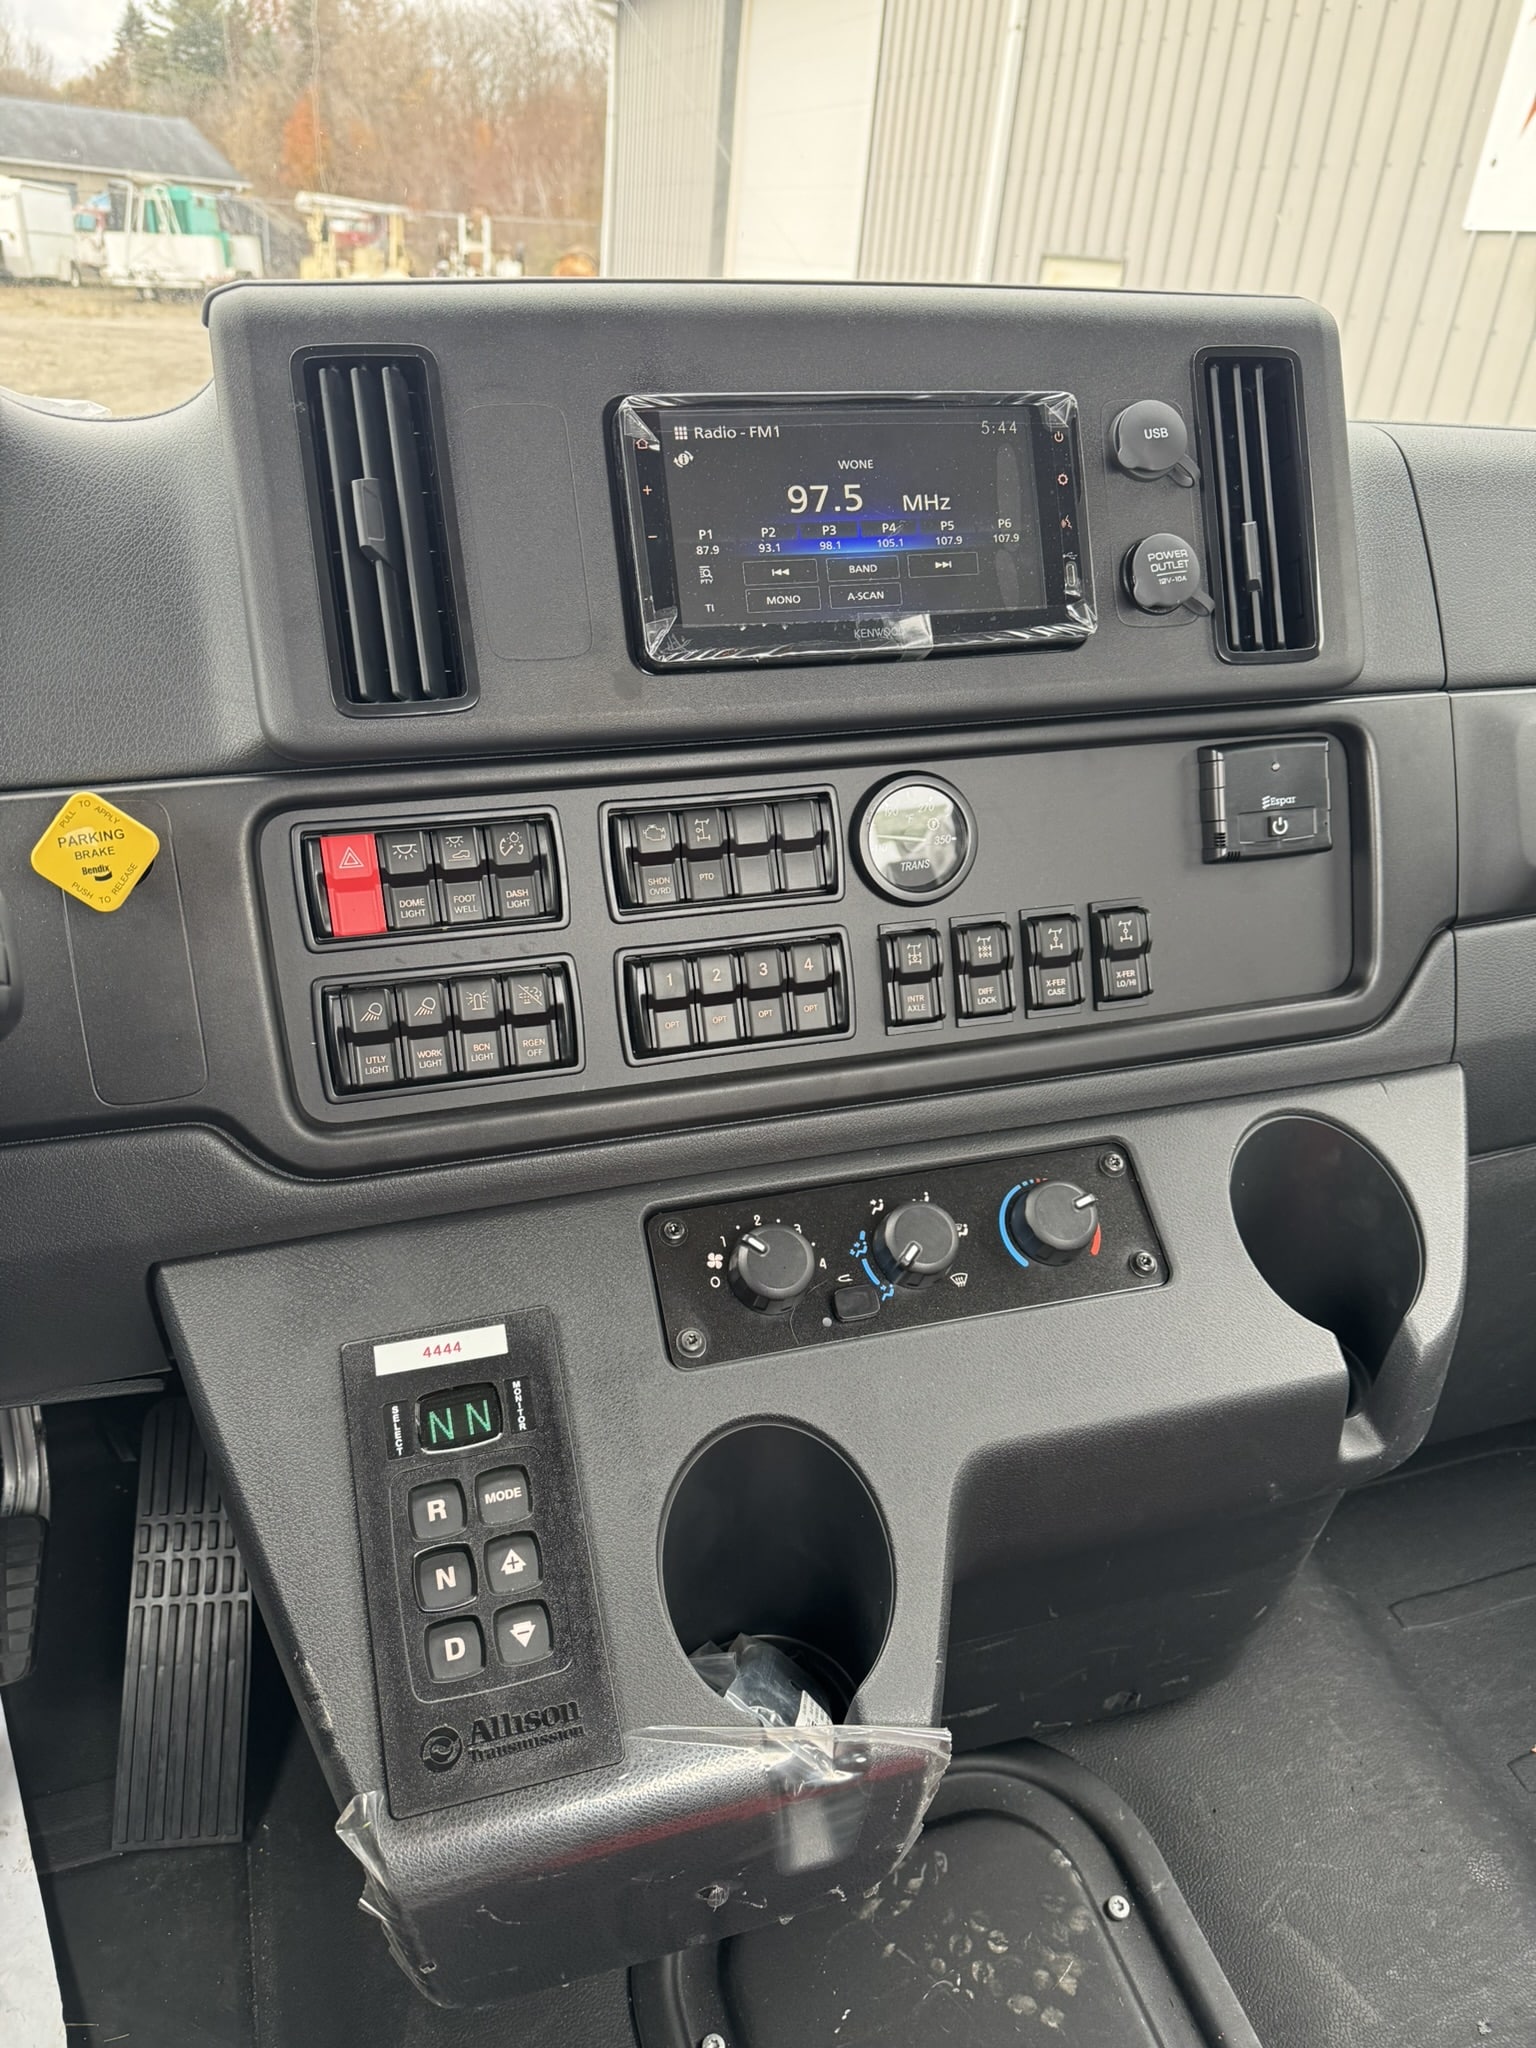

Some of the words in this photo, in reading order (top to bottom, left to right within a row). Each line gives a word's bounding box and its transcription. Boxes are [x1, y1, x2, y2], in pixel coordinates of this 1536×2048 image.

[694, 426, 737, 439] Radio
[750, 425, 780, 438] FM1
[981, 420, 1017, 434] 5:44
[1144, 427, 1169, 439] USB
[837, 459, 874, 470] WONE
[787, 484, 863, 514] 97.5
[902, 494, 951, 511] MHz
[882, 523, 897, 533] P4
[940, 520, 955, 531] P5
[998, 518, 1012, 528] P6
[698, 530, 713, 540] P1
[761, 527, 776, 538] P2
[822, 525, 837, 536] P3
[877, 538, 904, 548] 105.1
[935, 536, 963, 546] 107.9
[993, 533, 1020, 543] 107.9
[696, 545, 720, 555] 87.9
[758, 543, 781, 553] 93.1
[819, 541, 841, 550] 98.1
[1147, 549, 1188, 562] POWER
[849, 564, 878, 574] BAND
[1150, 560, 1189, 572] OUTLET
[766, 595, 801, 605] MONO
[847, 591, 885, 601] A-SCAN
[853, 626, 905, 639] KENWOO
[59, 810, 76, 828] PULL
[78, 799, 91, 808] TO
[94, 805, 120, 825] APPLY
[57, 828, 125, 848] PARKING
[934, 834, 951, 845] 350
[75, 846, 115, 860] BRAKE
[82, 864, 110, 876] Bendix
[900, 859, 930, 872] TRANS
[648, 876, 671, 886] SHDN
[699, 872, 715, 881] PTO
[71, 881, 94, 899] PUSH
[99, 895, 112, 904] TO
[111, 862, 138, 895] RELEASE
[505, 889, 529, 899] DASH
[649, 886, 671, 896] OVRD
[399, 897, 425, 908] DOME
[453, 893, 476, 904] FOOT
[454, 904, 479, 914] WELL
[506, 899, 530, 909] LIGHT
[400, 908, 426, 918] LIGHT
[759, 962, 768, 976] 3
[804, 957, 813, 971] 4
[712, 968, 721, 982] 2
[1116, 969, 1136, 979] X-FER
[666, 972, 673, 987] 1
[1046, 978, 1066, 987] X-FER
[1117, 978, 1137, 988] LO/HI
[978, 987, 994, 996] DIFF
[1047, 987, 1066, 996] CASE
[907, 995, 925, 1003] INTR
[977, 996, 997, 1005] LOCK
[803, 1004, 818, 1013] OPT
[907, 1003, 926, 1012] AXLE
[758, 1009, 773, 1018] OPT
[665, 1020, 680, 1029] OPT
[712, 1015, 728, 1024] OPT
[473, 1042, 491, 1051] BCN
[522, 1039, 546, 1048] RGEN
[416, 1048, 442, 1058] WORK
[471, 1052, 495, 1062] LIGHT
[527, 1048, 544, 1057] OFF
[366, 1055, 387, 1065] UTLY
[418, 1058, 443, 1069] LIGHT
[365, 1065, 389, 1075] LIGHT
[753, 1214, 762, 1226] 2
[720, 1235, 727, 1247] 1
[819, 1257, 827, 1270] 4
[422, 1341, 463, 1358] 4444
[512, 1380, 527, 1431] MONITOR
[428, 1407, 454, 1444] N
[465, 1399, 491, 1435] N
[391, 1405, 403, 1456] SELECT
[484, 1487, 523, 1505] MODE
[427, 1498, 448, 1522] R
[435, 1566, 456, 1591] N
[444, 1636, 466, 1662] D
[467, 1701, 583, 1747] Allison
